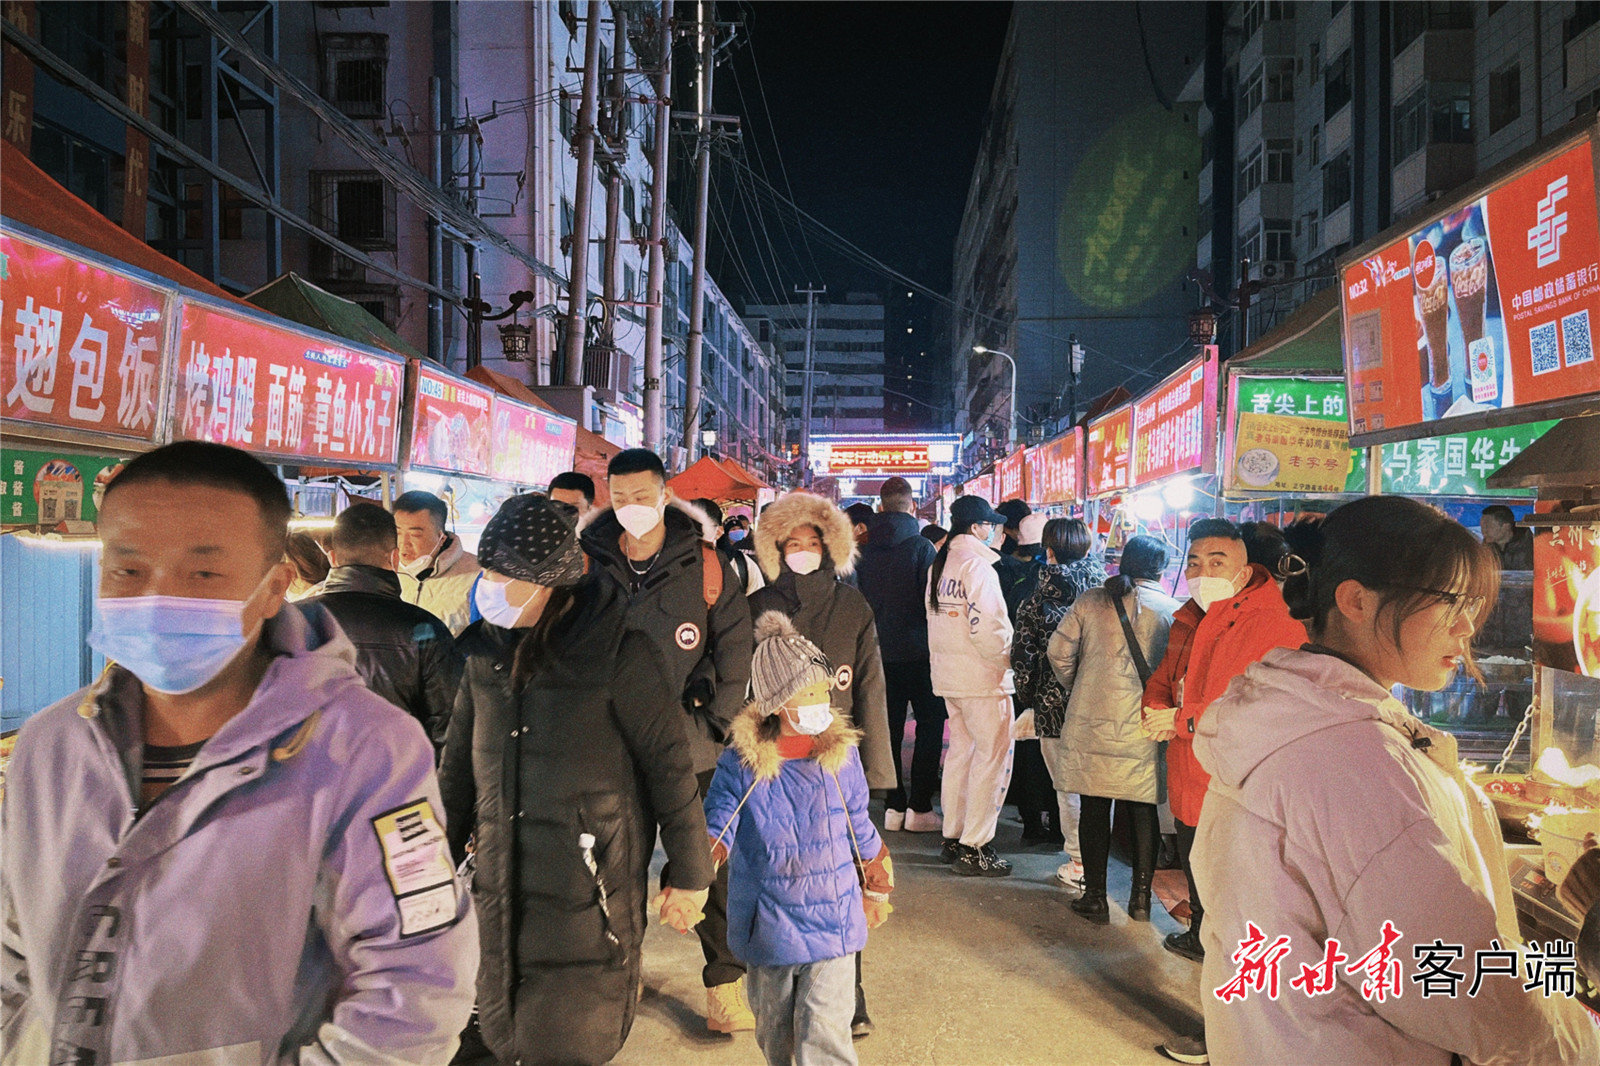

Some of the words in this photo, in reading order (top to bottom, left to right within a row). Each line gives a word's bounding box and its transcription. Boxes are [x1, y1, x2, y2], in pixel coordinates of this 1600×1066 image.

[1512, 263, 1598, 311] 中国邮政储蓄银行
[1513, 309, 1533, 320] POSTAL
[1534, 300, 1557, 314] SAVINGS
[1558, 295, 1572, 305] BANK
[1574, 291, 1580, 300] OF
[1582, 284, 1600, 296] CHINA
[0, 296, 159, 431] 翅包饭
[182, 340, 257, 444] 烤鸡腿
[265, 363, 307, 448] 面筋
[313, 371, 392, 458] 章鱼小丸子
[1250, 393, 1344, 416] 舌尖上的
[1288, 455, 1339, 471] 老字号
[1364, 437, 1536, 482] 马家国华牛
